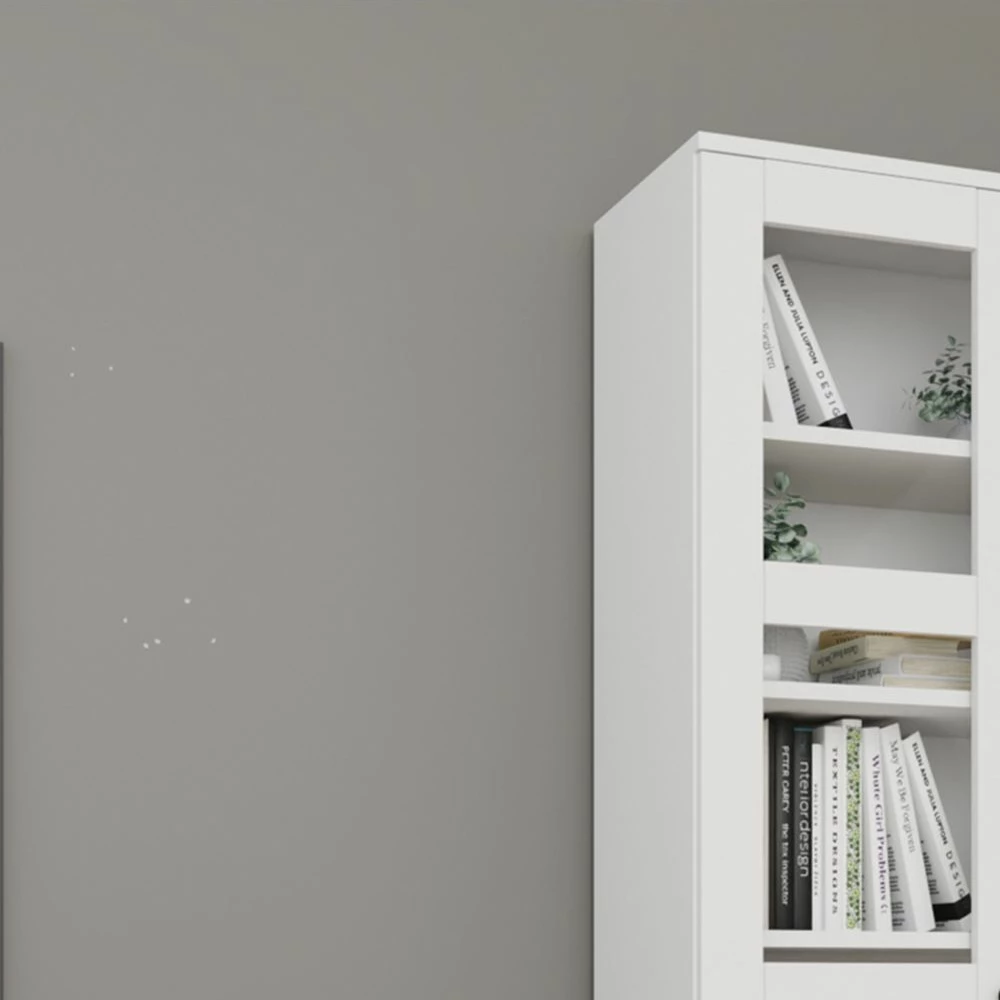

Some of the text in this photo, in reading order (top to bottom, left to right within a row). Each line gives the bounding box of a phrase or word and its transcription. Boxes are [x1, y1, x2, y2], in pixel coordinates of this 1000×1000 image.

[771, 263, 786, 288] ELLEN
[782, 289, 795, 308] AND
[790, 308, 805, 332] JULIA
[800, 331, 819, 365] LUPTON
[781, 745, 790, 778] PETER
[889, 739, 900, 765] May
[896, 766, 906, 788] We
[781, 779, 790, 813] CAREY
[912, 742, 924, 766] ELLEN
[919, 767, 930, 788] AND
[926, 788, 938, 812] JULIA
[933, 811, 949, 845] LUPTON
[781, 823, 789, 836] the
[874, 806, 884, 835] Girl
[780, 858, 789, 906] inspector
[876, 836, 888, 901] Problems
